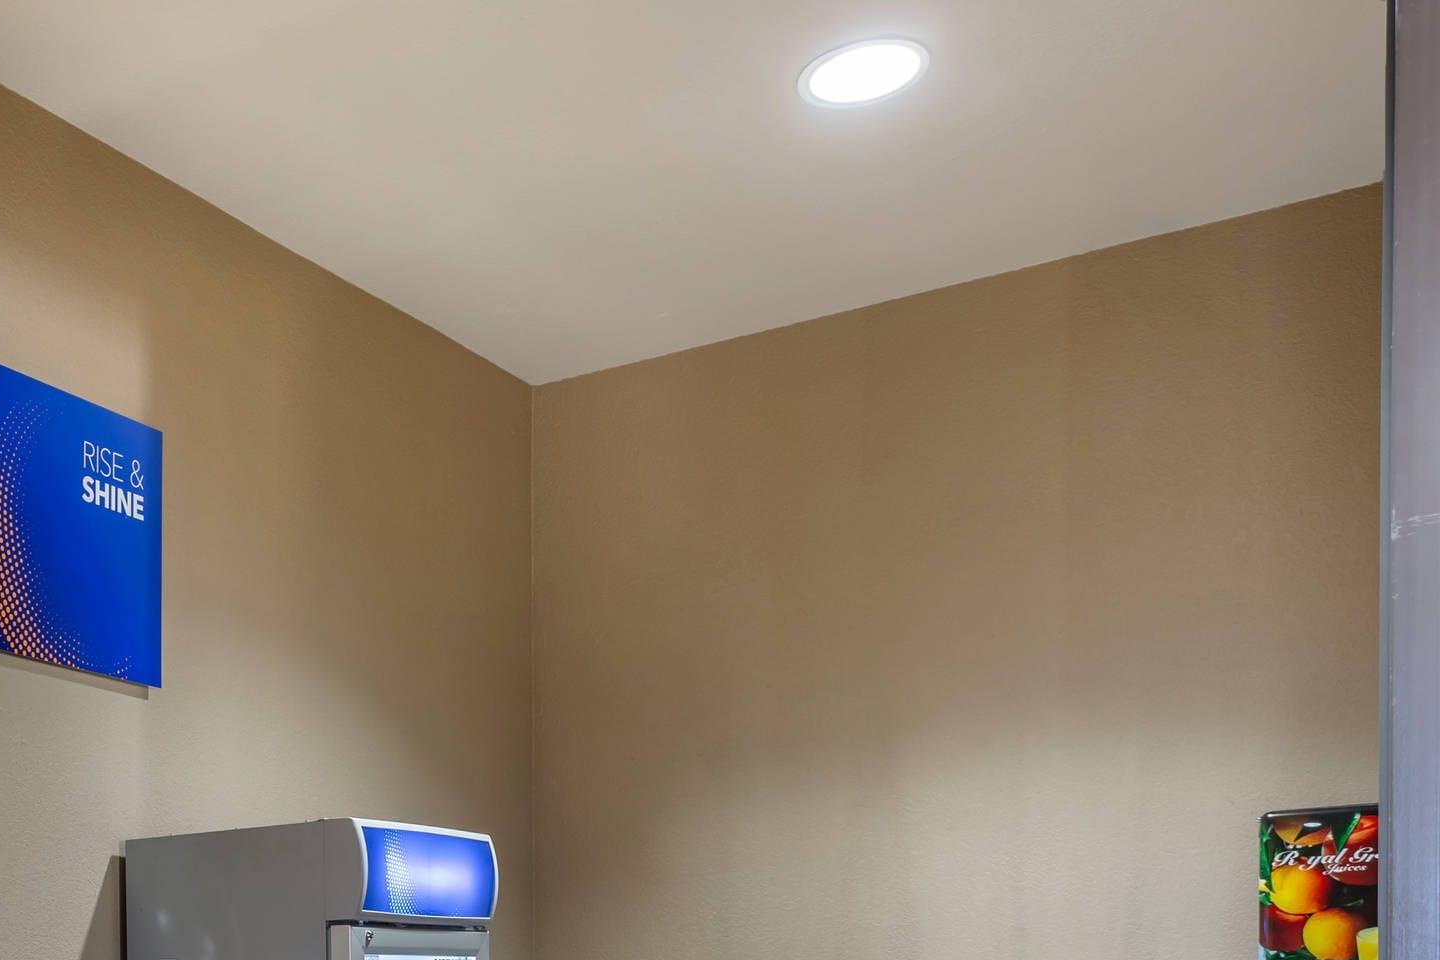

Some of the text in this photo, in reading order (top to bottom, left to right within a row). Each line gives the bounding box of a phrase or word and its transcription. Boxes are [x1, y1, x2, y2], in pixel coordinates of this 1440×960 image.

[83, 440, 144, 490] RISE &
[82, 475, 145, 522] SHINE
[1272, 848, 1348, 871] Ryal
[1323, 863, 1368, 875] Juices
